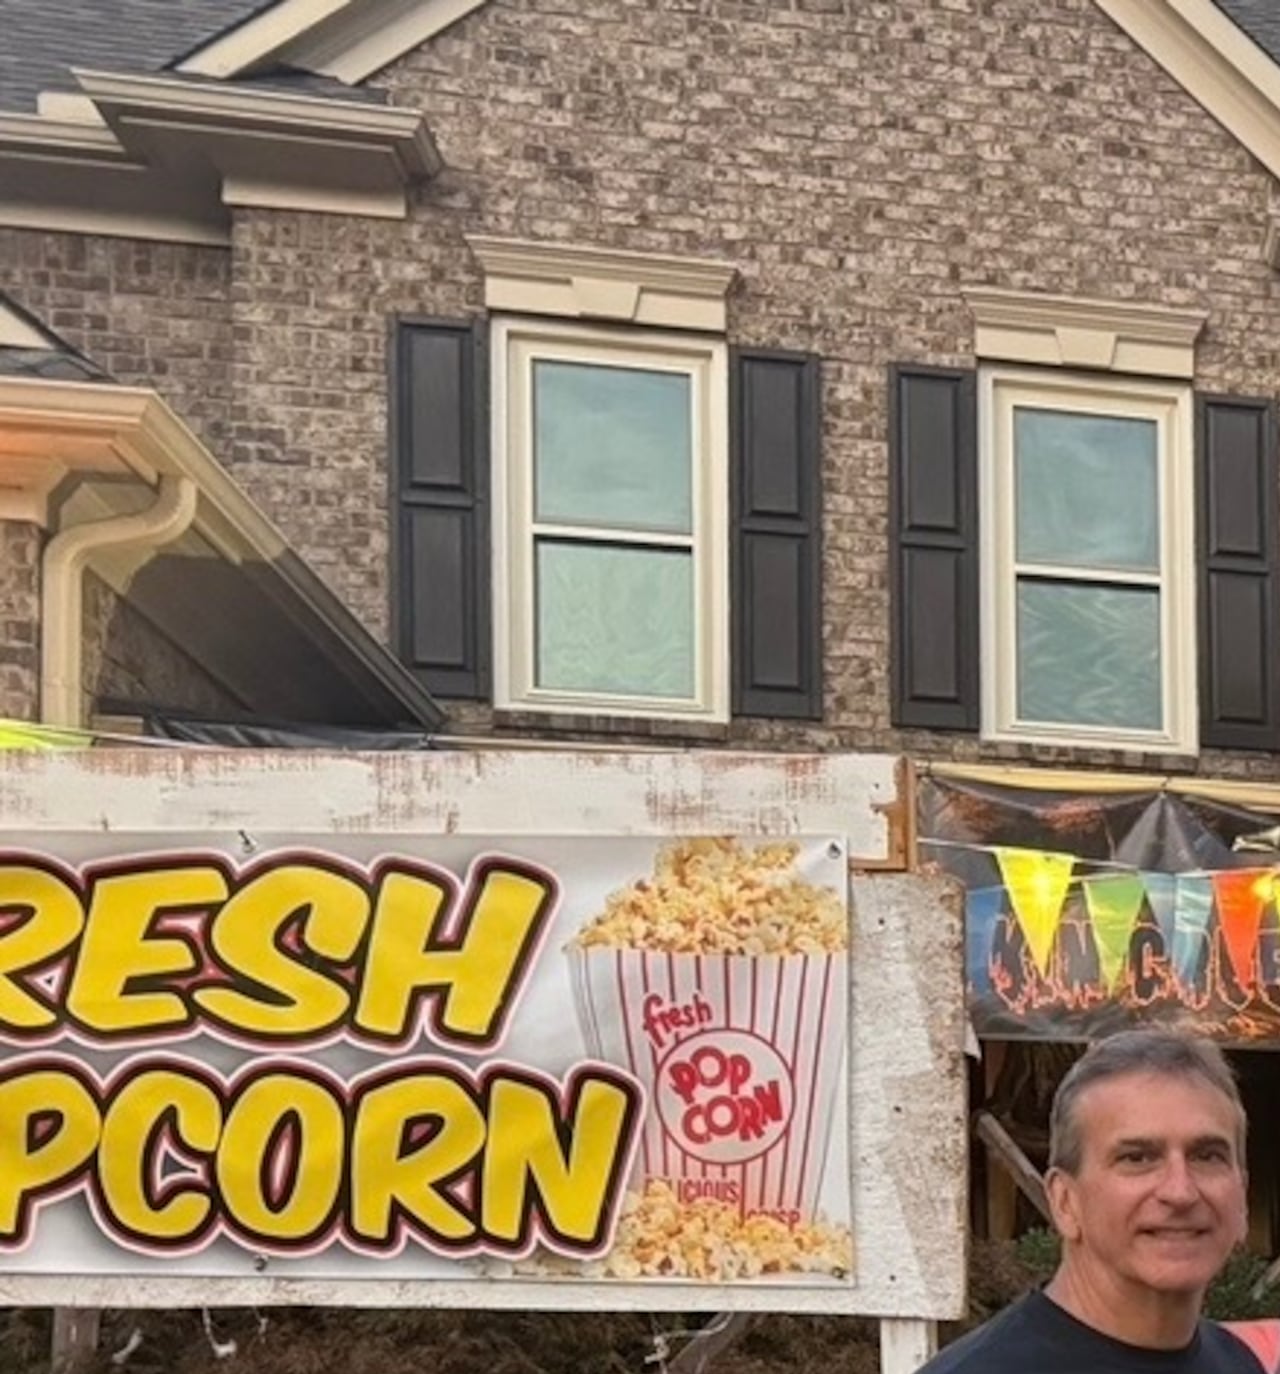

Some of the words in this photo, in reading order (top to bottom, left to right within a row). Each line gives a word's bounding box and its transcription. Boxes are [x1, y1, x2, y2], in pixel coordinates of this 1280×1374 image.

[643, 994, 712, 1048] fresh
[669, 1046, 751, 1104] POP
[682, 1080, 784, 1144] CORN
